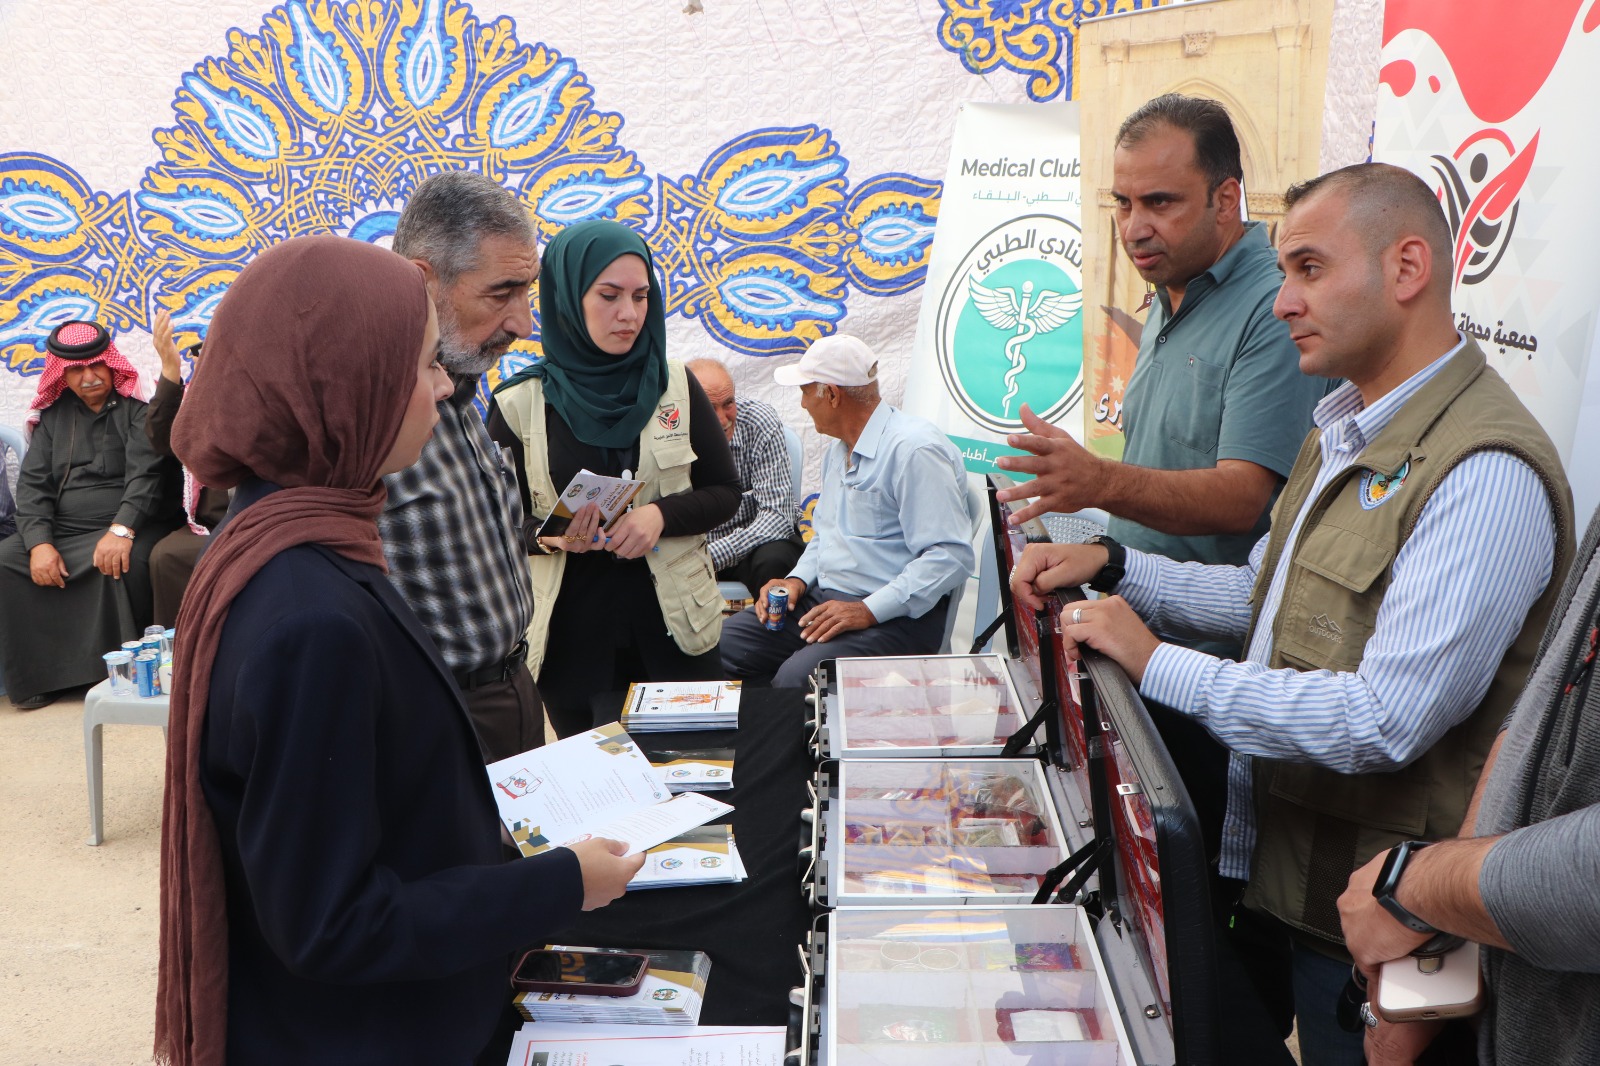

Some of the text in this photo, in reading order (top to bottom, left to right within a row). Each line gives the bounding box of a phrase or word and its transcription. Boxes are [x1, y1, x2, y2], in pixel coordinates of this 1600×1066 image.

[961, 157, 1081, 177] Medical Club
[977, 229, 1082, 275] نادي الطبي
[1457, 312, 1537, 360] جمعية محطة
[1309, 625, 1342, 644] OUTDOORS
